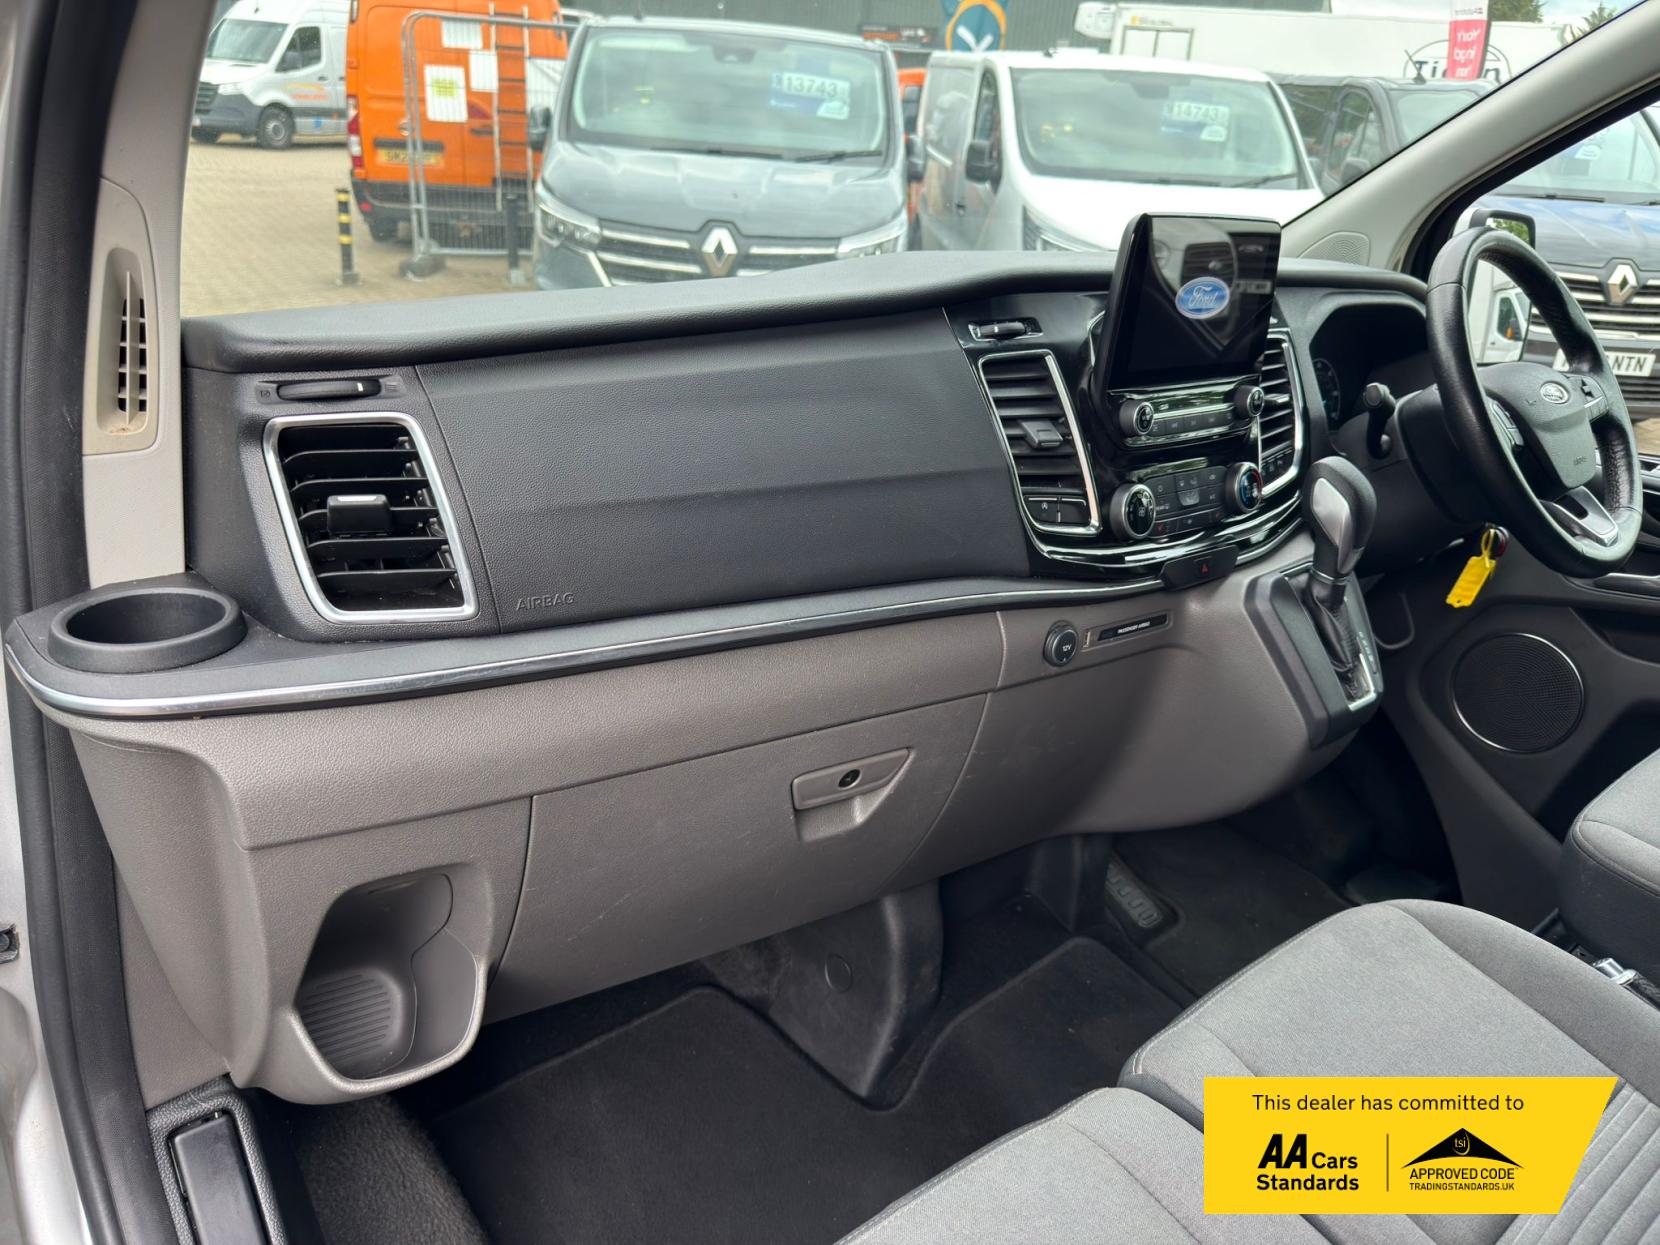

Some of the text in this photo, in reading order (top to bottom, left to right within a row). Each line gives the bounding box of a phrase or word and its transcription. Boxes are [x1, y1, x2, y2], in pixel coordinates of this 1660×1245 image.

[1188, 285, 1218, 307] Ford
[1612, 354, 1647, 373] NTN
[516, 592, 575, 611] AIRBAG
